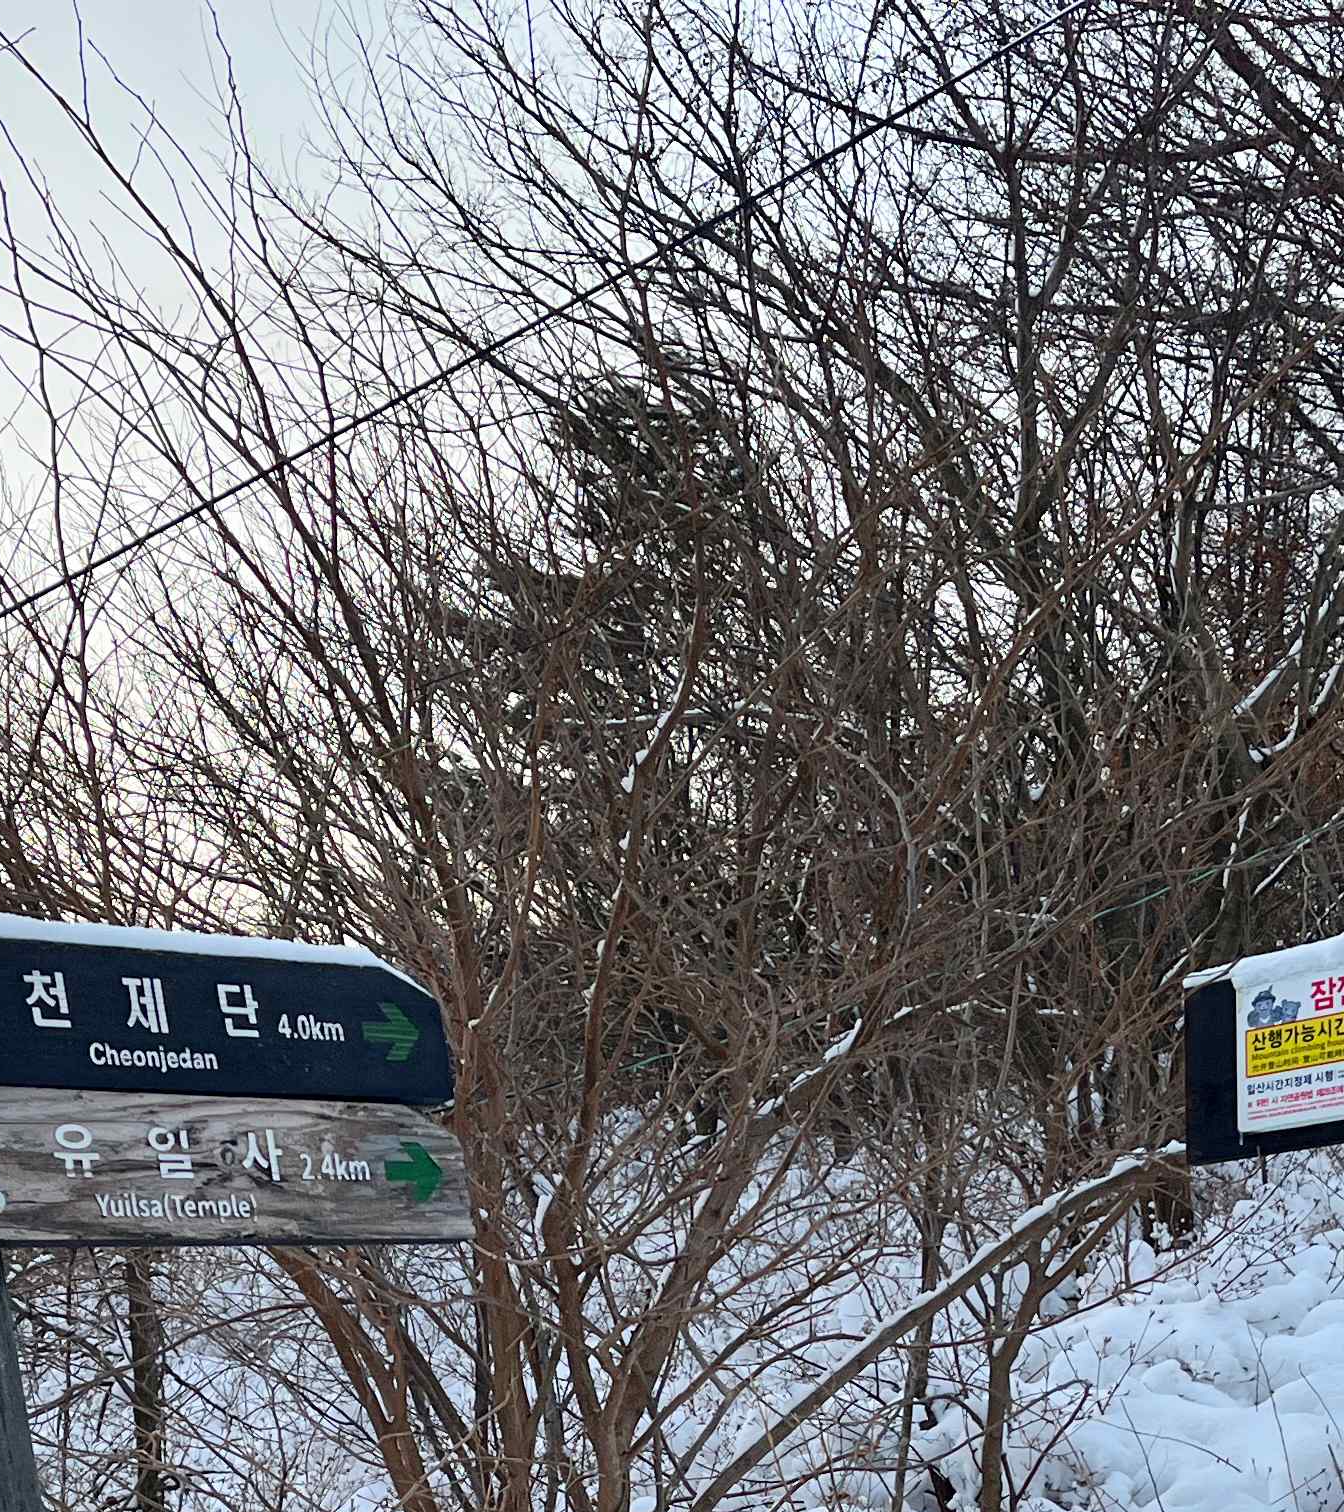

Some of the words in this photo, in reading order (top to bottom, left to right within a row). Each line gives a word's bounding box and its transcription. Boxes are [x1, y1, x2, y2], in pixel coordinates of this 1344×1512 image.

[278, 1013, 345, 1042] 4.0km
[89, 1042, 219, 1073] Cheonjedan
[299, 1152, 371, 1182] 2.4km
[95, 1193, 258, 1222] Yuilsa(Temple)
